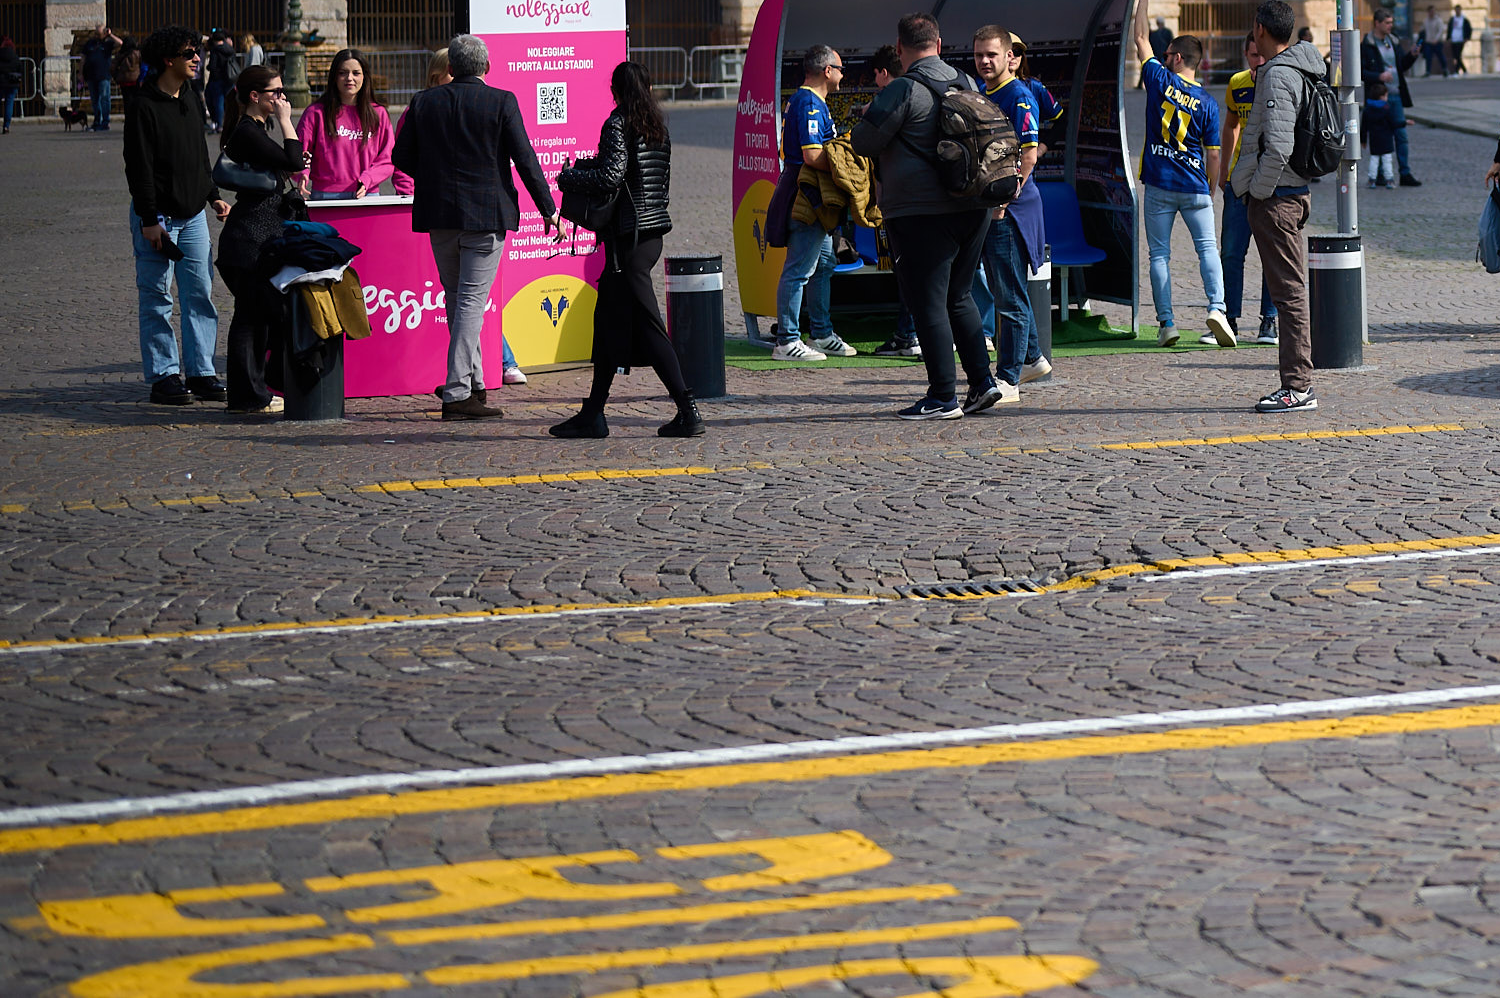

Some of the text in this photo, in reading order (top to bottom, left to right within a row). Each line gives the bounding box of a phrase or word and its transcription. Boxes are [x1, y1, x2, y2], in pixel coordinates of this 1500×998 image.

[527, 46, 575, 58] NOLEGGIARE
[507, 59, 594, 72] TI PORTA ALLO STADIO!
[1164, 85, 1201, 111] DJURIC
[737, 90, 774, 125] noleggiare
[1161, 100, 1192, 152] 11
[534, 138, 540, 147] ti
[540, 136, 562, 148] regala
[563, 137, 577, 146] uno
[745, 132, 769, 150] TI PORTA
[738, 155, 775, 174] ALLO STADIO!
[511, 236, 530, 247] trovi
[578, 233, 595, 242] oltre
[509, 251, 519, 261] 50
[519, 248, 550, 259] location
